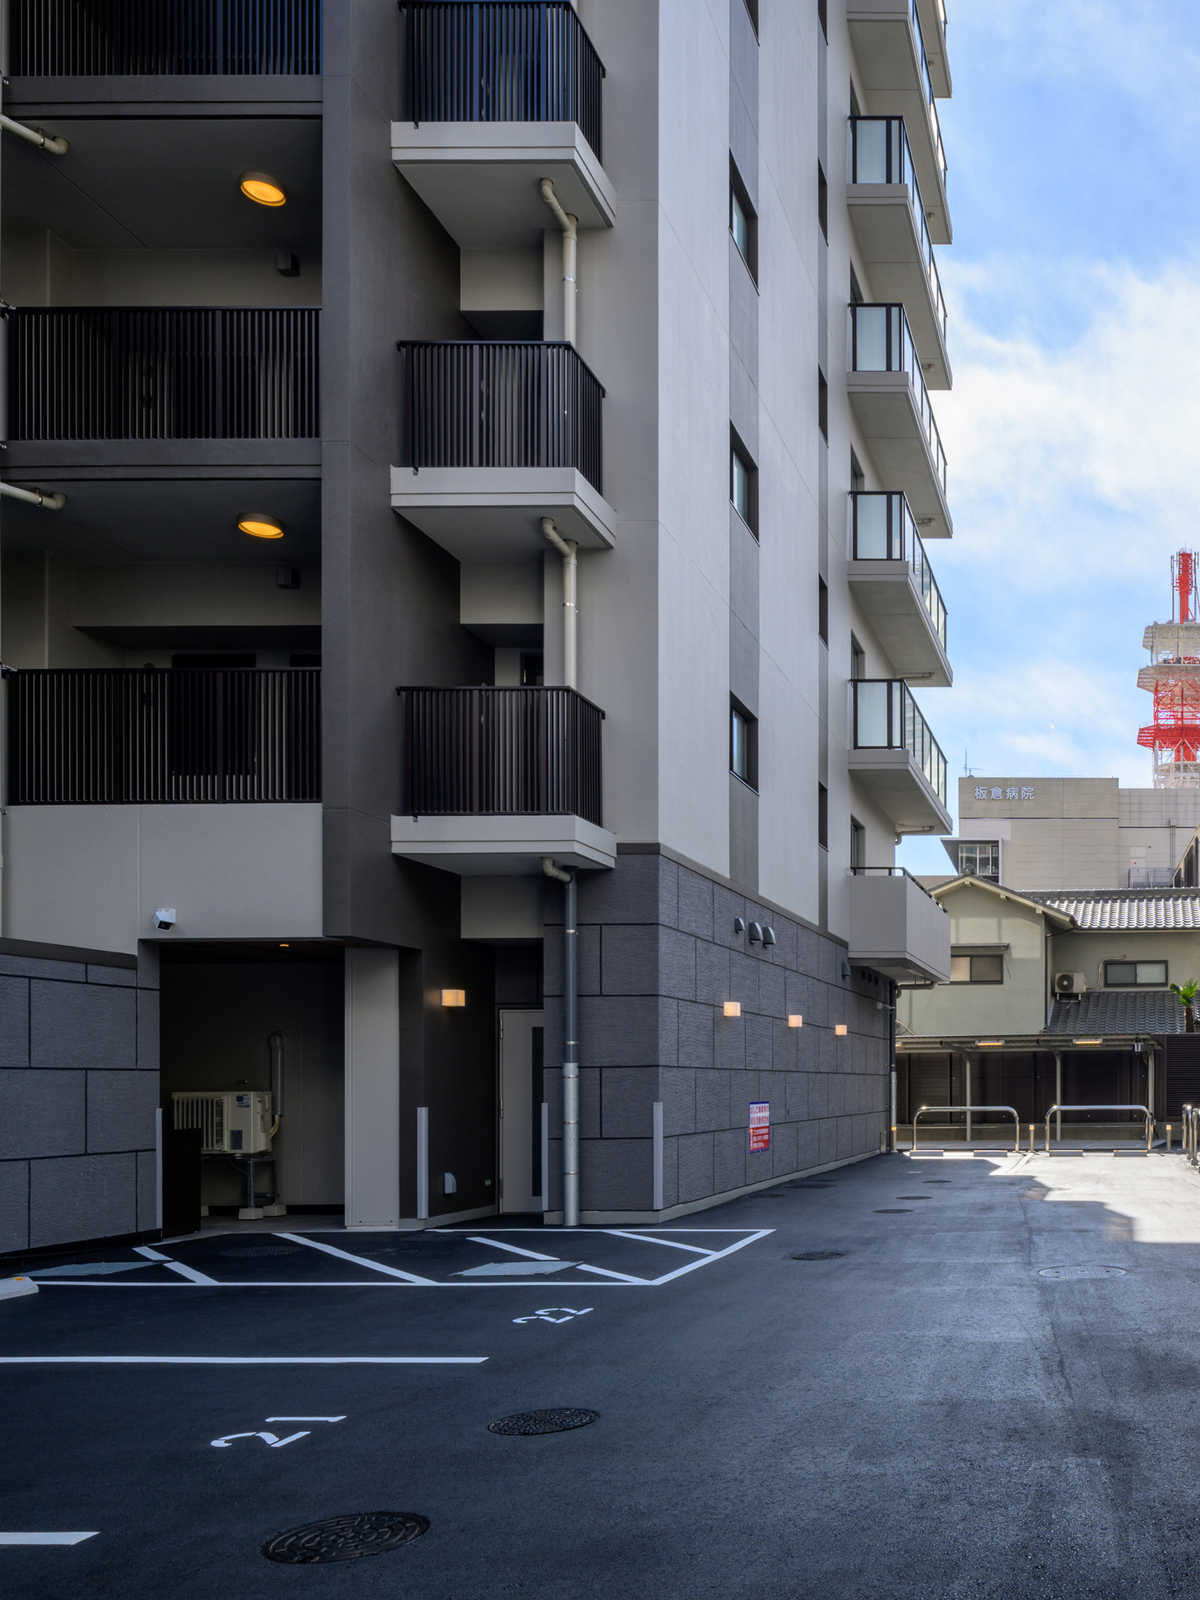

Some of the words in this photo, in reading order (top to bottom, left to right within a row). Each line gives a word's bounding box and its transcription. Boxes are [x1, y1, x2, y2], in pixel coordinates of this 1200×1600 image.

[974, 786, 1035, 800] 板倉病院
[511, 1307, 595, 1324] 22
[210, 1415, 347, 1448] 21
